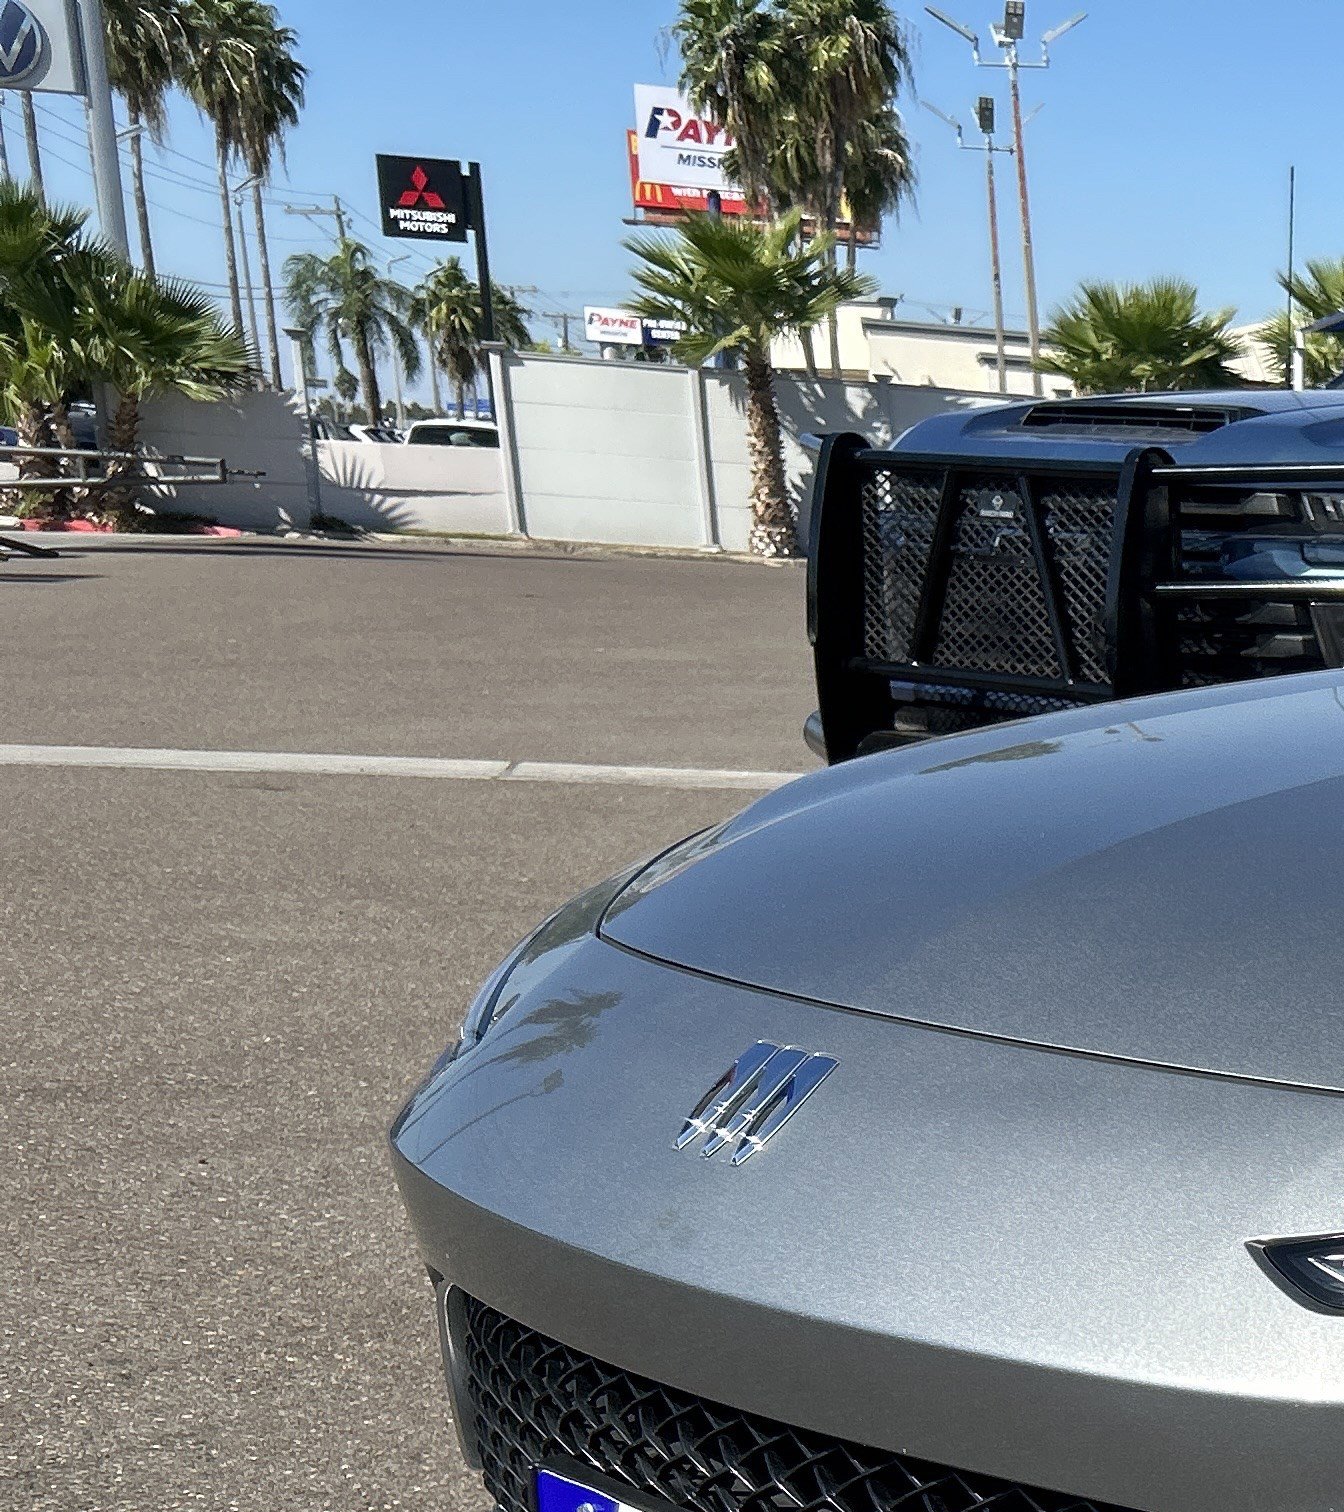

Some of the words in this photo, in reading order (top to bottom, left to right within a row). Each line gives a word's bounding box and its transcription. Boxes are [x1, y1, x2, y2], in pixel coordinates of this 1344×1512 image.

[389, 208, 456, 224] MITSUBISHI
[399, 220, 449, 234] MOTORS
[588, 312, 638, 329] PAYNE
